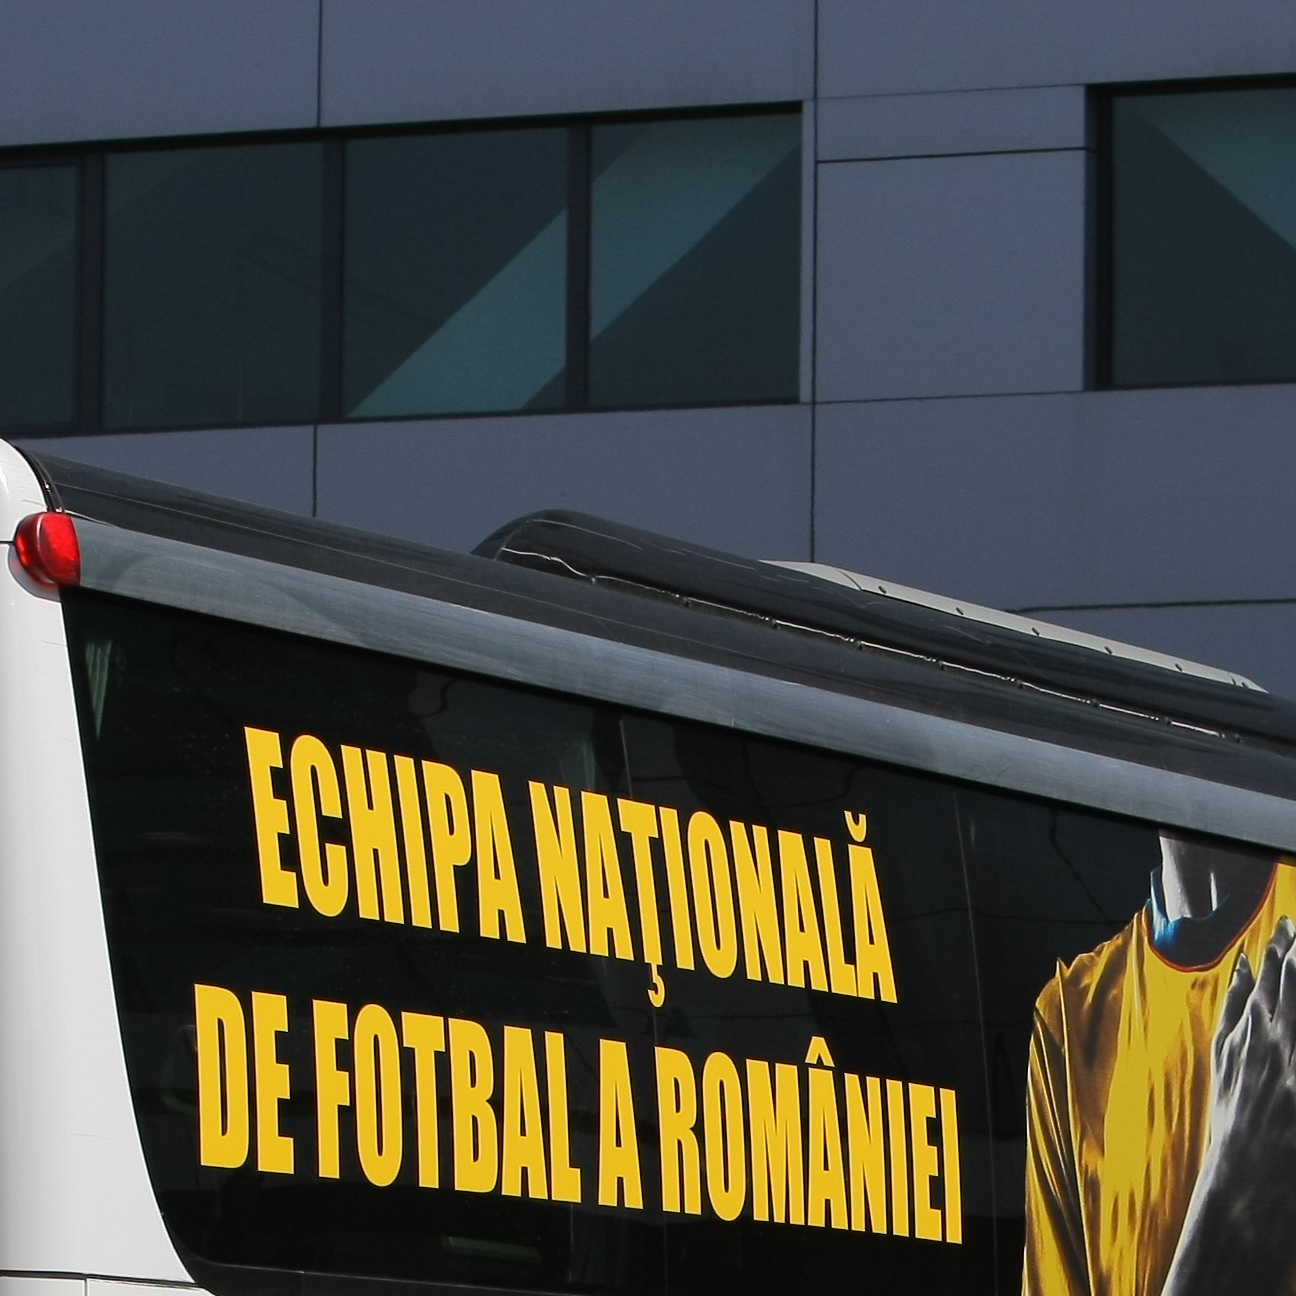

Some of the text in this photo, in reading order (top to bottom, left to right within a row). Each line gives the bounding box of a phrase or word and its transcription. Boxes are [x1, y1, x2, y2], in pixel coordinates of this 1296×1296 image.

[244, 726, 527, 944] ECHIPA
[193, 983, 963, 1245] DE FOTBAL A ROMÂNIEI
